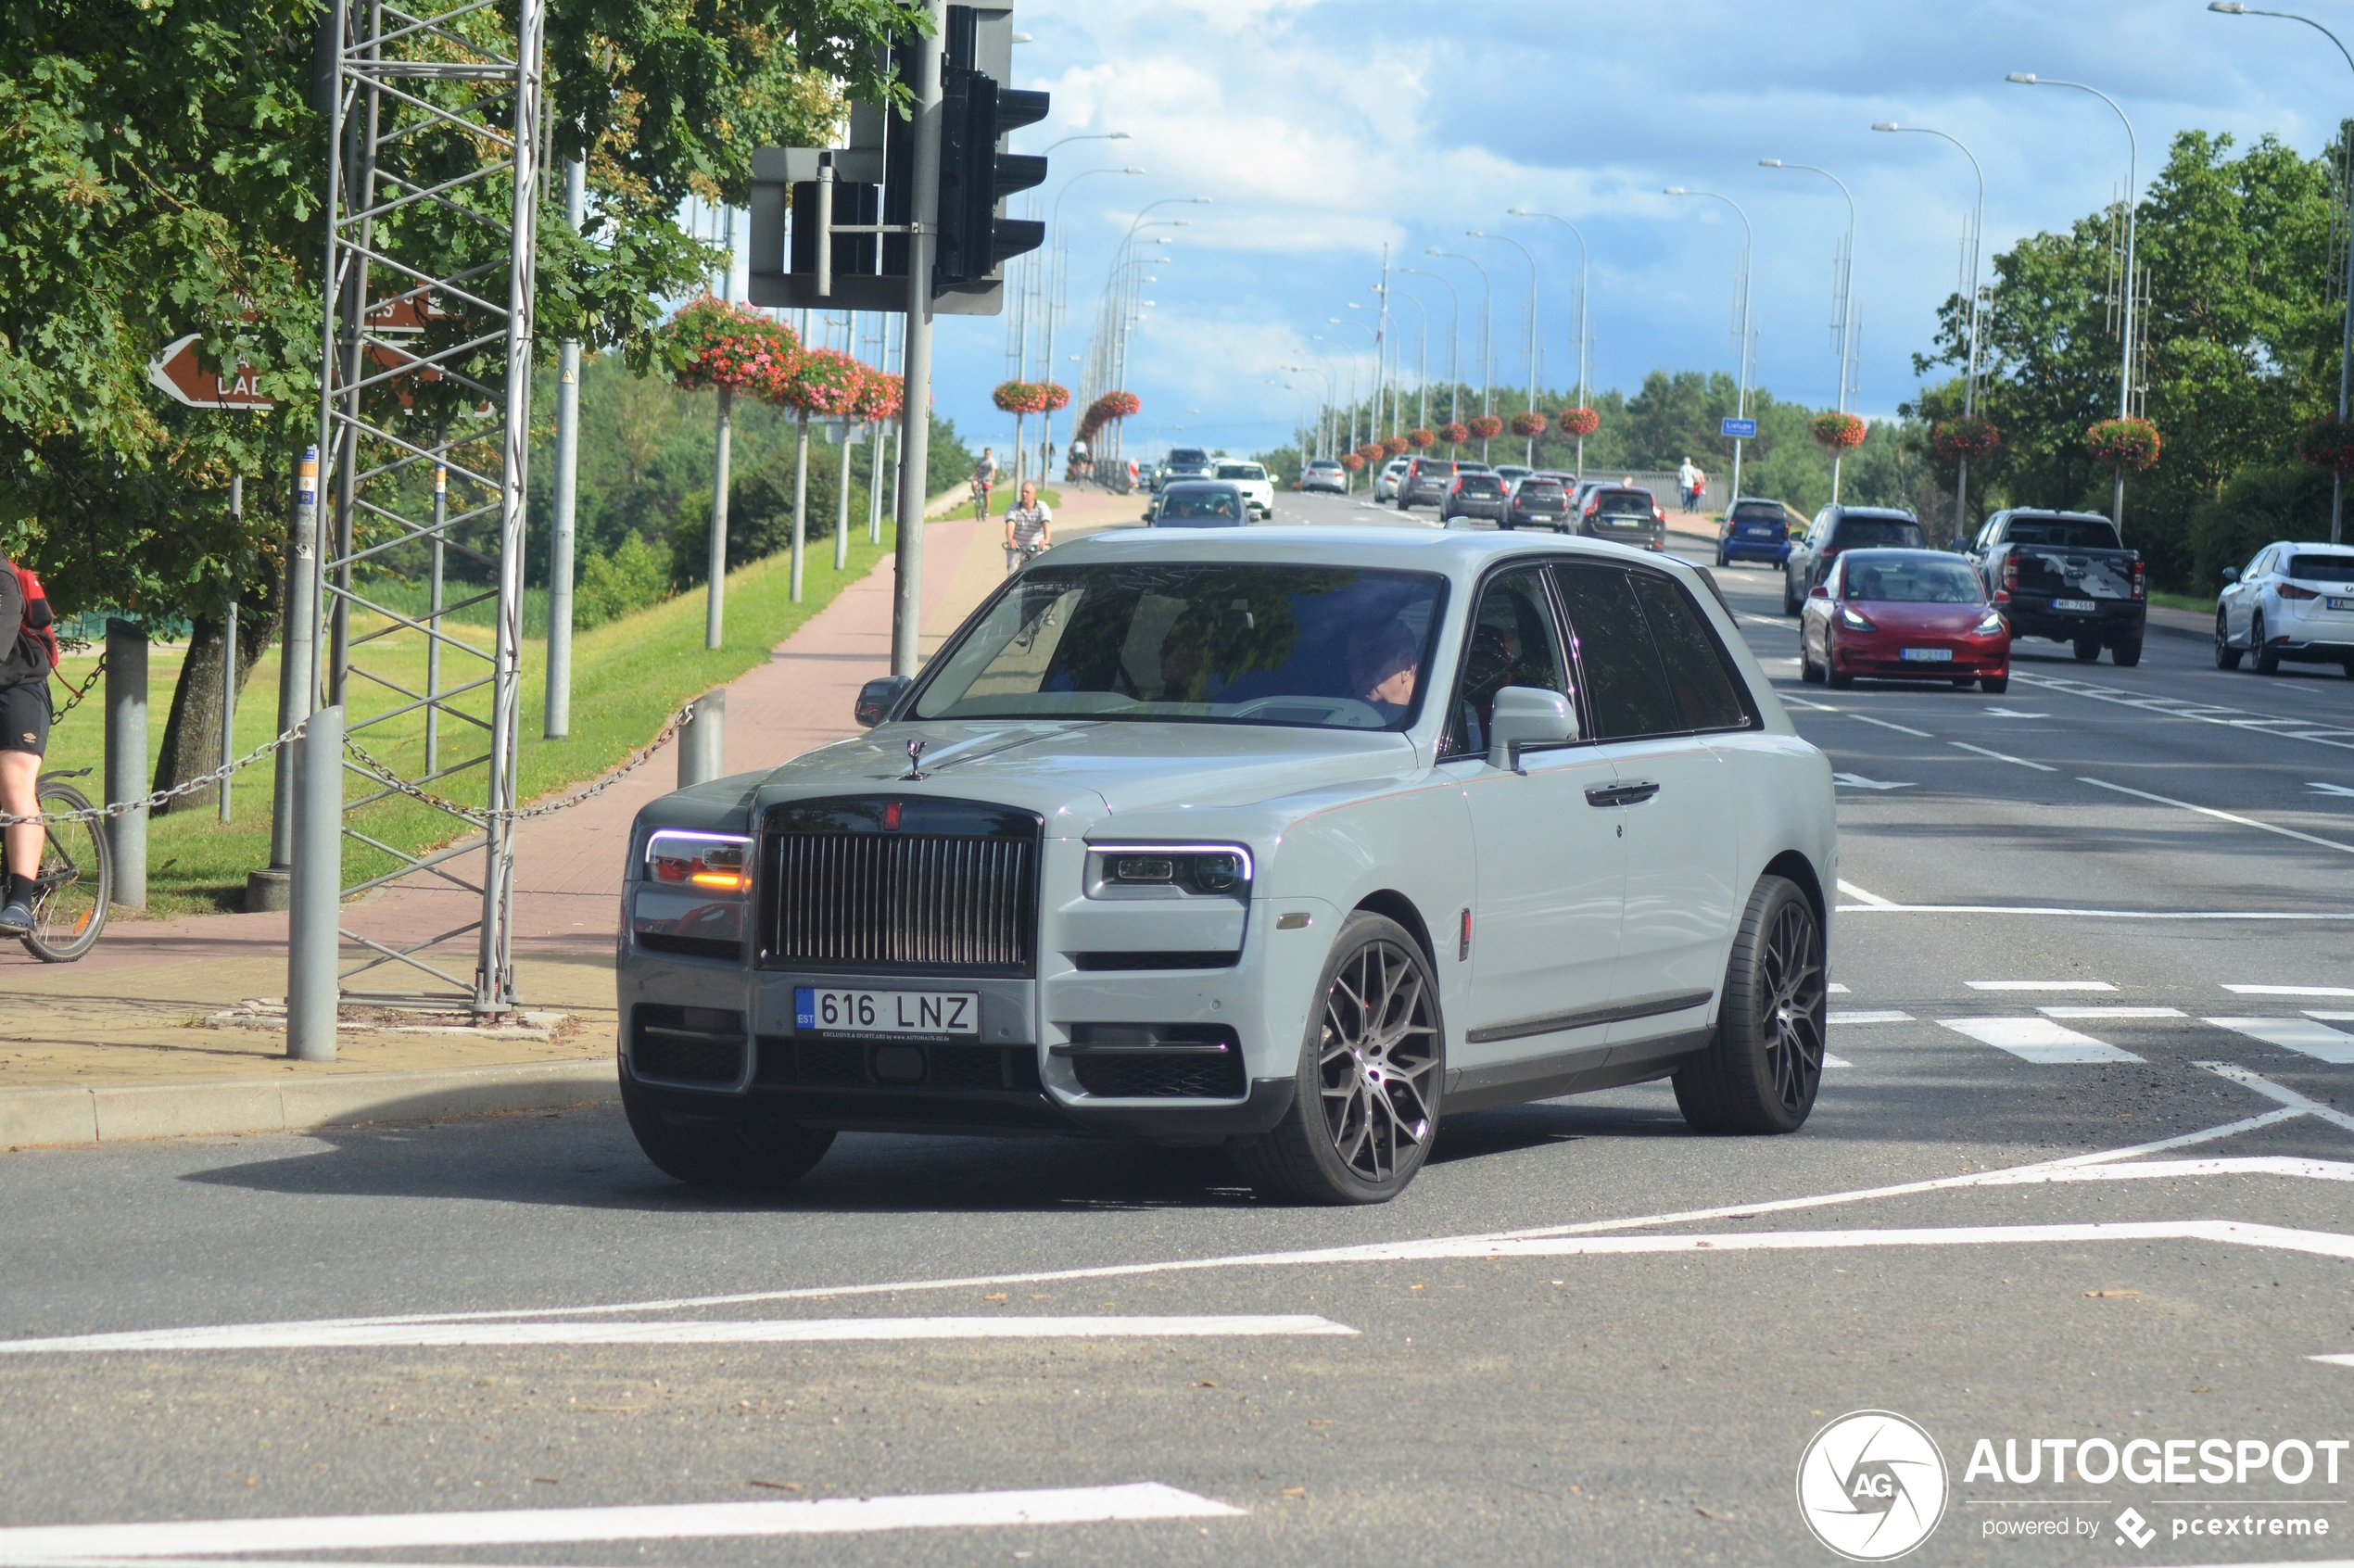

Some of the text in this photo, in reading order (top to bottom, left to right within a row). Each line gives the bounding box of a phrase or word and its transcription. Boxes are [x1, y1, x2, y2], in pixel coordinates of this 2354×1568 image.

[797, 1014, 815, 1024] EST
[821, 993, 969, 1030] 616 LNZ
